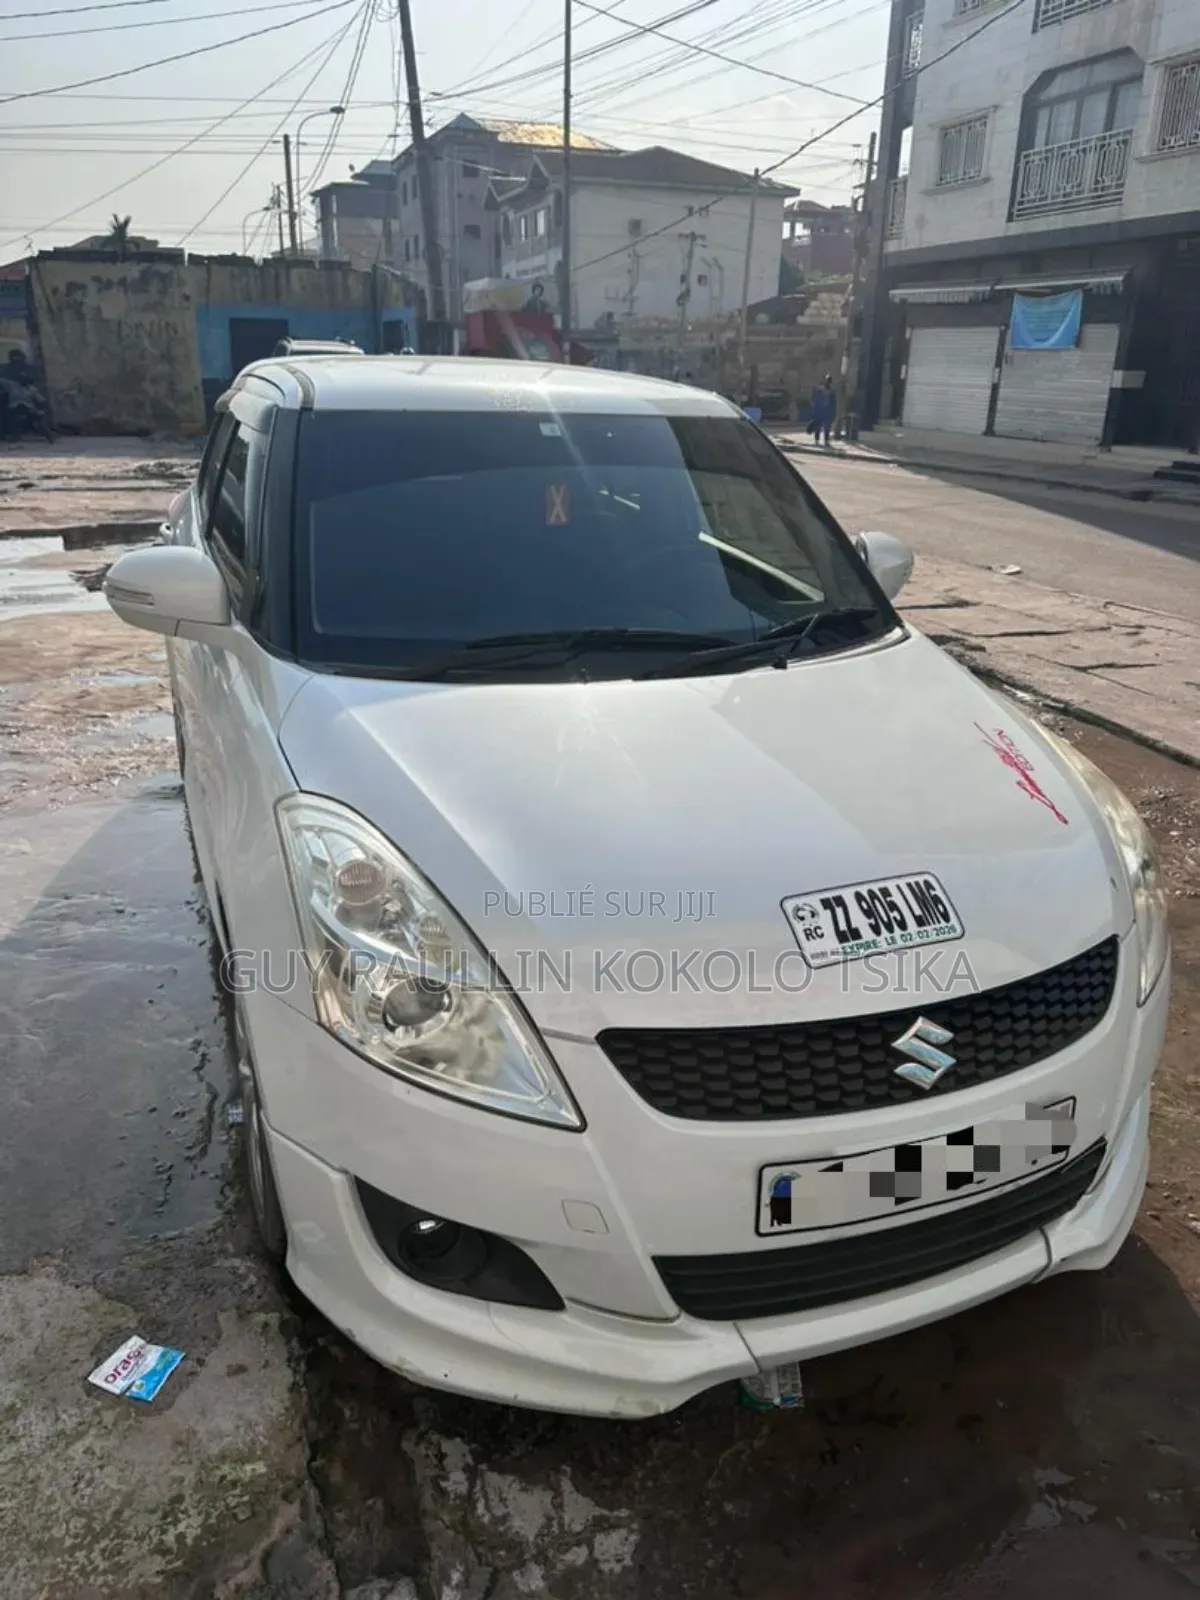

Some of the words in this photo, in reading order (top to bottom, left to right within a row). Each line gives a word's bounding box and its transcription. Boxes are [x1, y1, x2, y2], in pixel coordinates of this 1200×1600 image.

[819, 894, 863, 944] ZZ
[854, 886, 908, 937] 905
[899, 879, 951, 928] LM6
[803, 925, 825, 942] RC
[884, 935, 897, 946] LE
